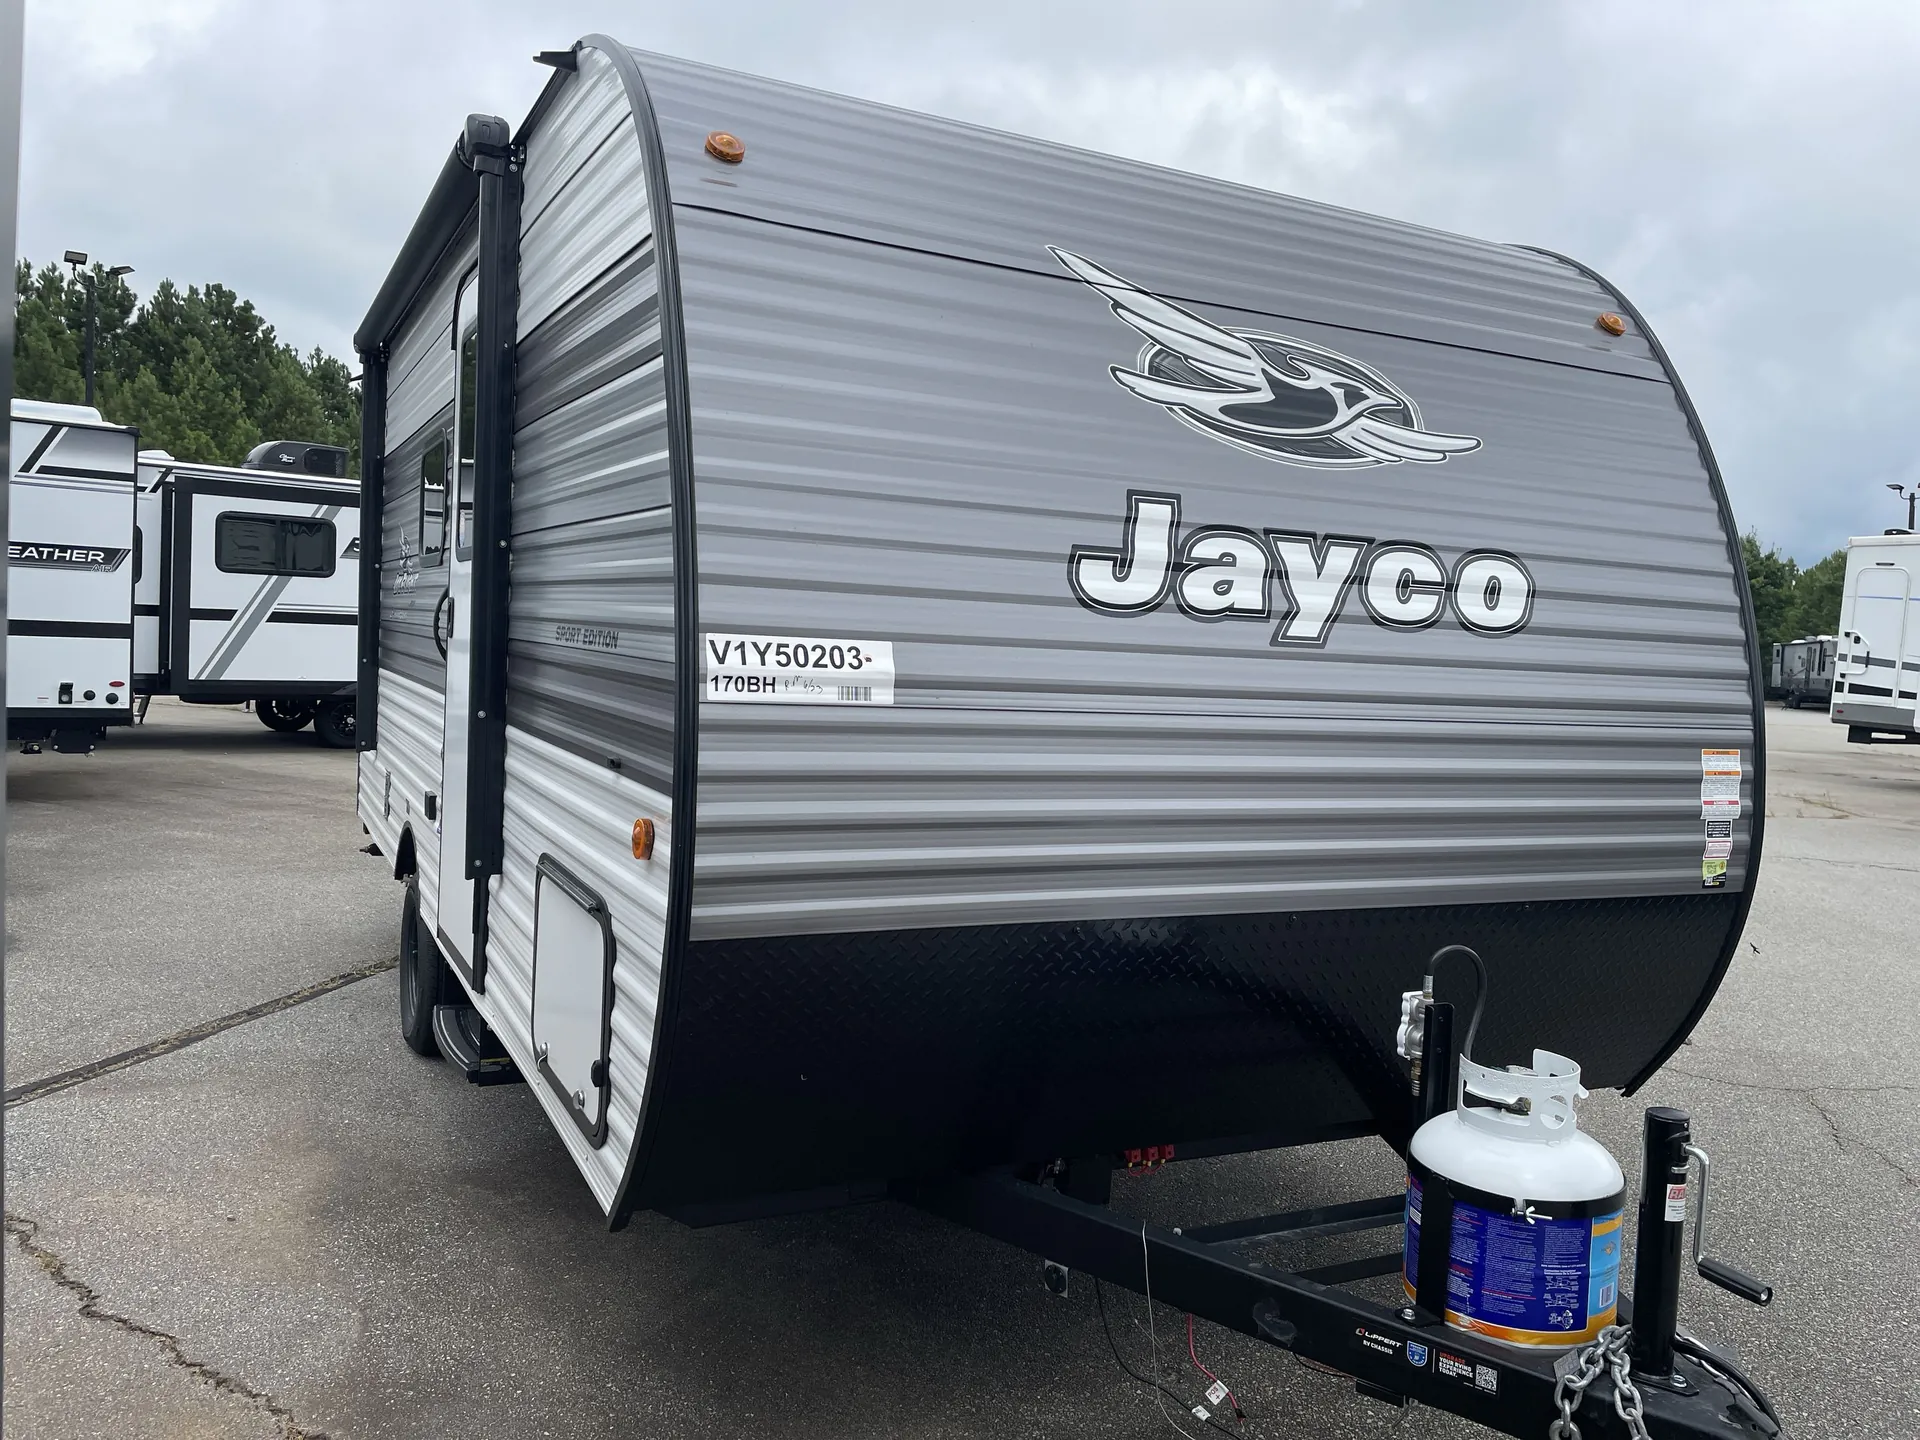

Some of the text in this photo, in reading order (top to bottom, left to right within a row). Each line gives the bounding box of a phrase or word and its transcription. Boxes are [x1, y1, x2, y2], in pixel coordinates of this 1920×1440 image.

[91, 564, 113, 573] AIR
[1067, 488, 1536, 650] Jayco
[556, 625, 619, 649] SPORT EDITION
[708, 639, 863, 670] V1Y50203
[710, 674, 776, 693] 170BH
[1363, 1339, 1393, 1355] RV CHASSIS
[1439, 1356, 1472, 1372] YOUR RVING
[1439, 1362, 1474, 1378] EXPERIENCE
[1439, 1367, 1458, 1378] TODAY.
[1207, 1386, 1219, 1397] POS
